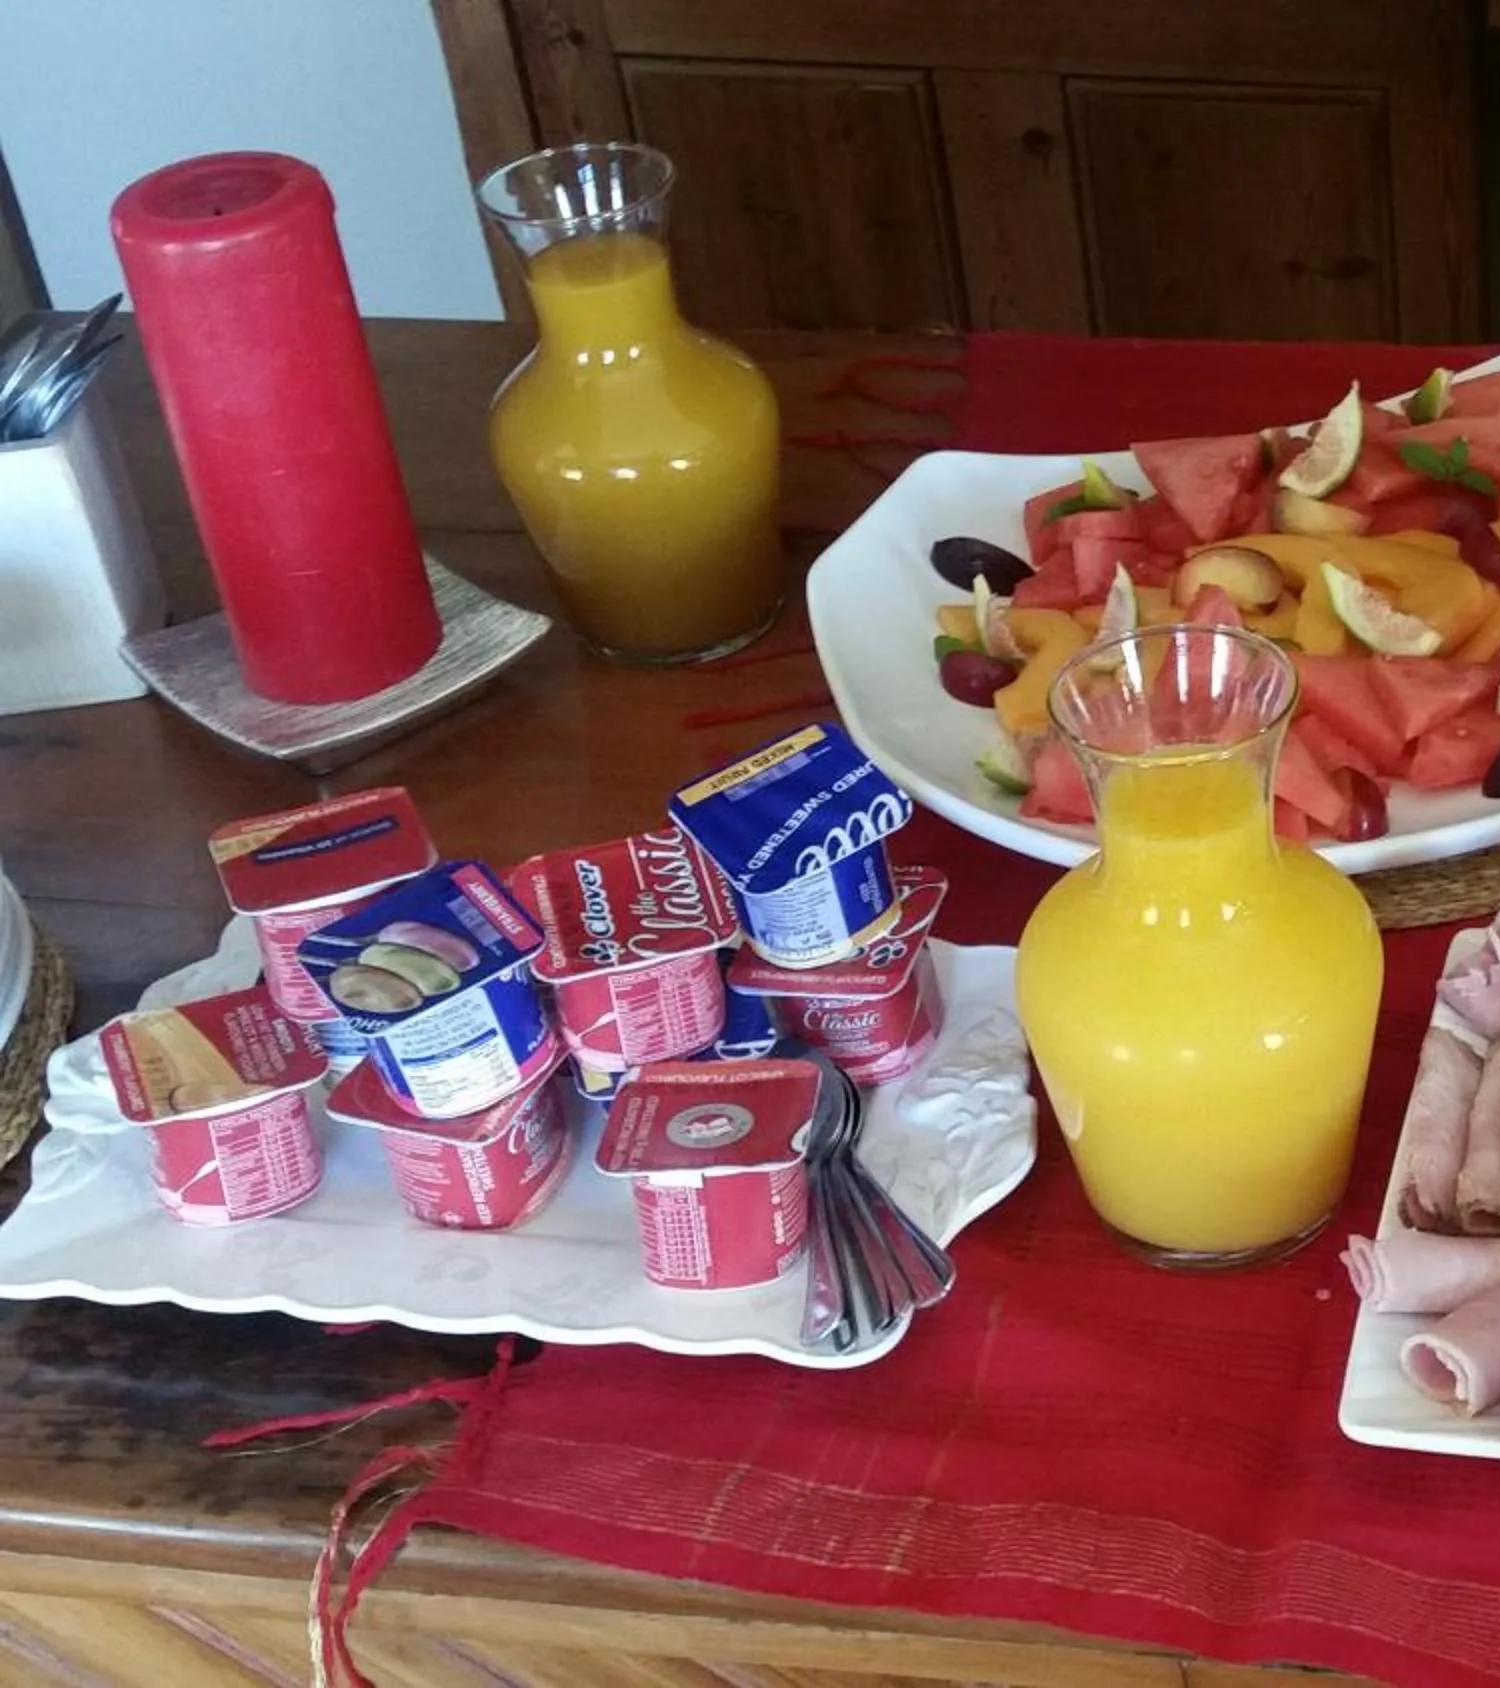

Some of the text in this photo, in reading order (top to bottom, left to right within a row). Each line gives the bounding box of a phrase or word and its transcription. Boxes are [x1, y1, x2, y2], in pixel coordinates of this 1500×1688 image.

[710, 744, 794, 790] MIXED FRUIT
[747, 790, 832, 869] SWEETENED
[575, 860, 615, 937] Clover
[627, 826, 719, 958] Classic
[629, 892, 660, 915] the
[803, 1009, 881, 1030] Classic
